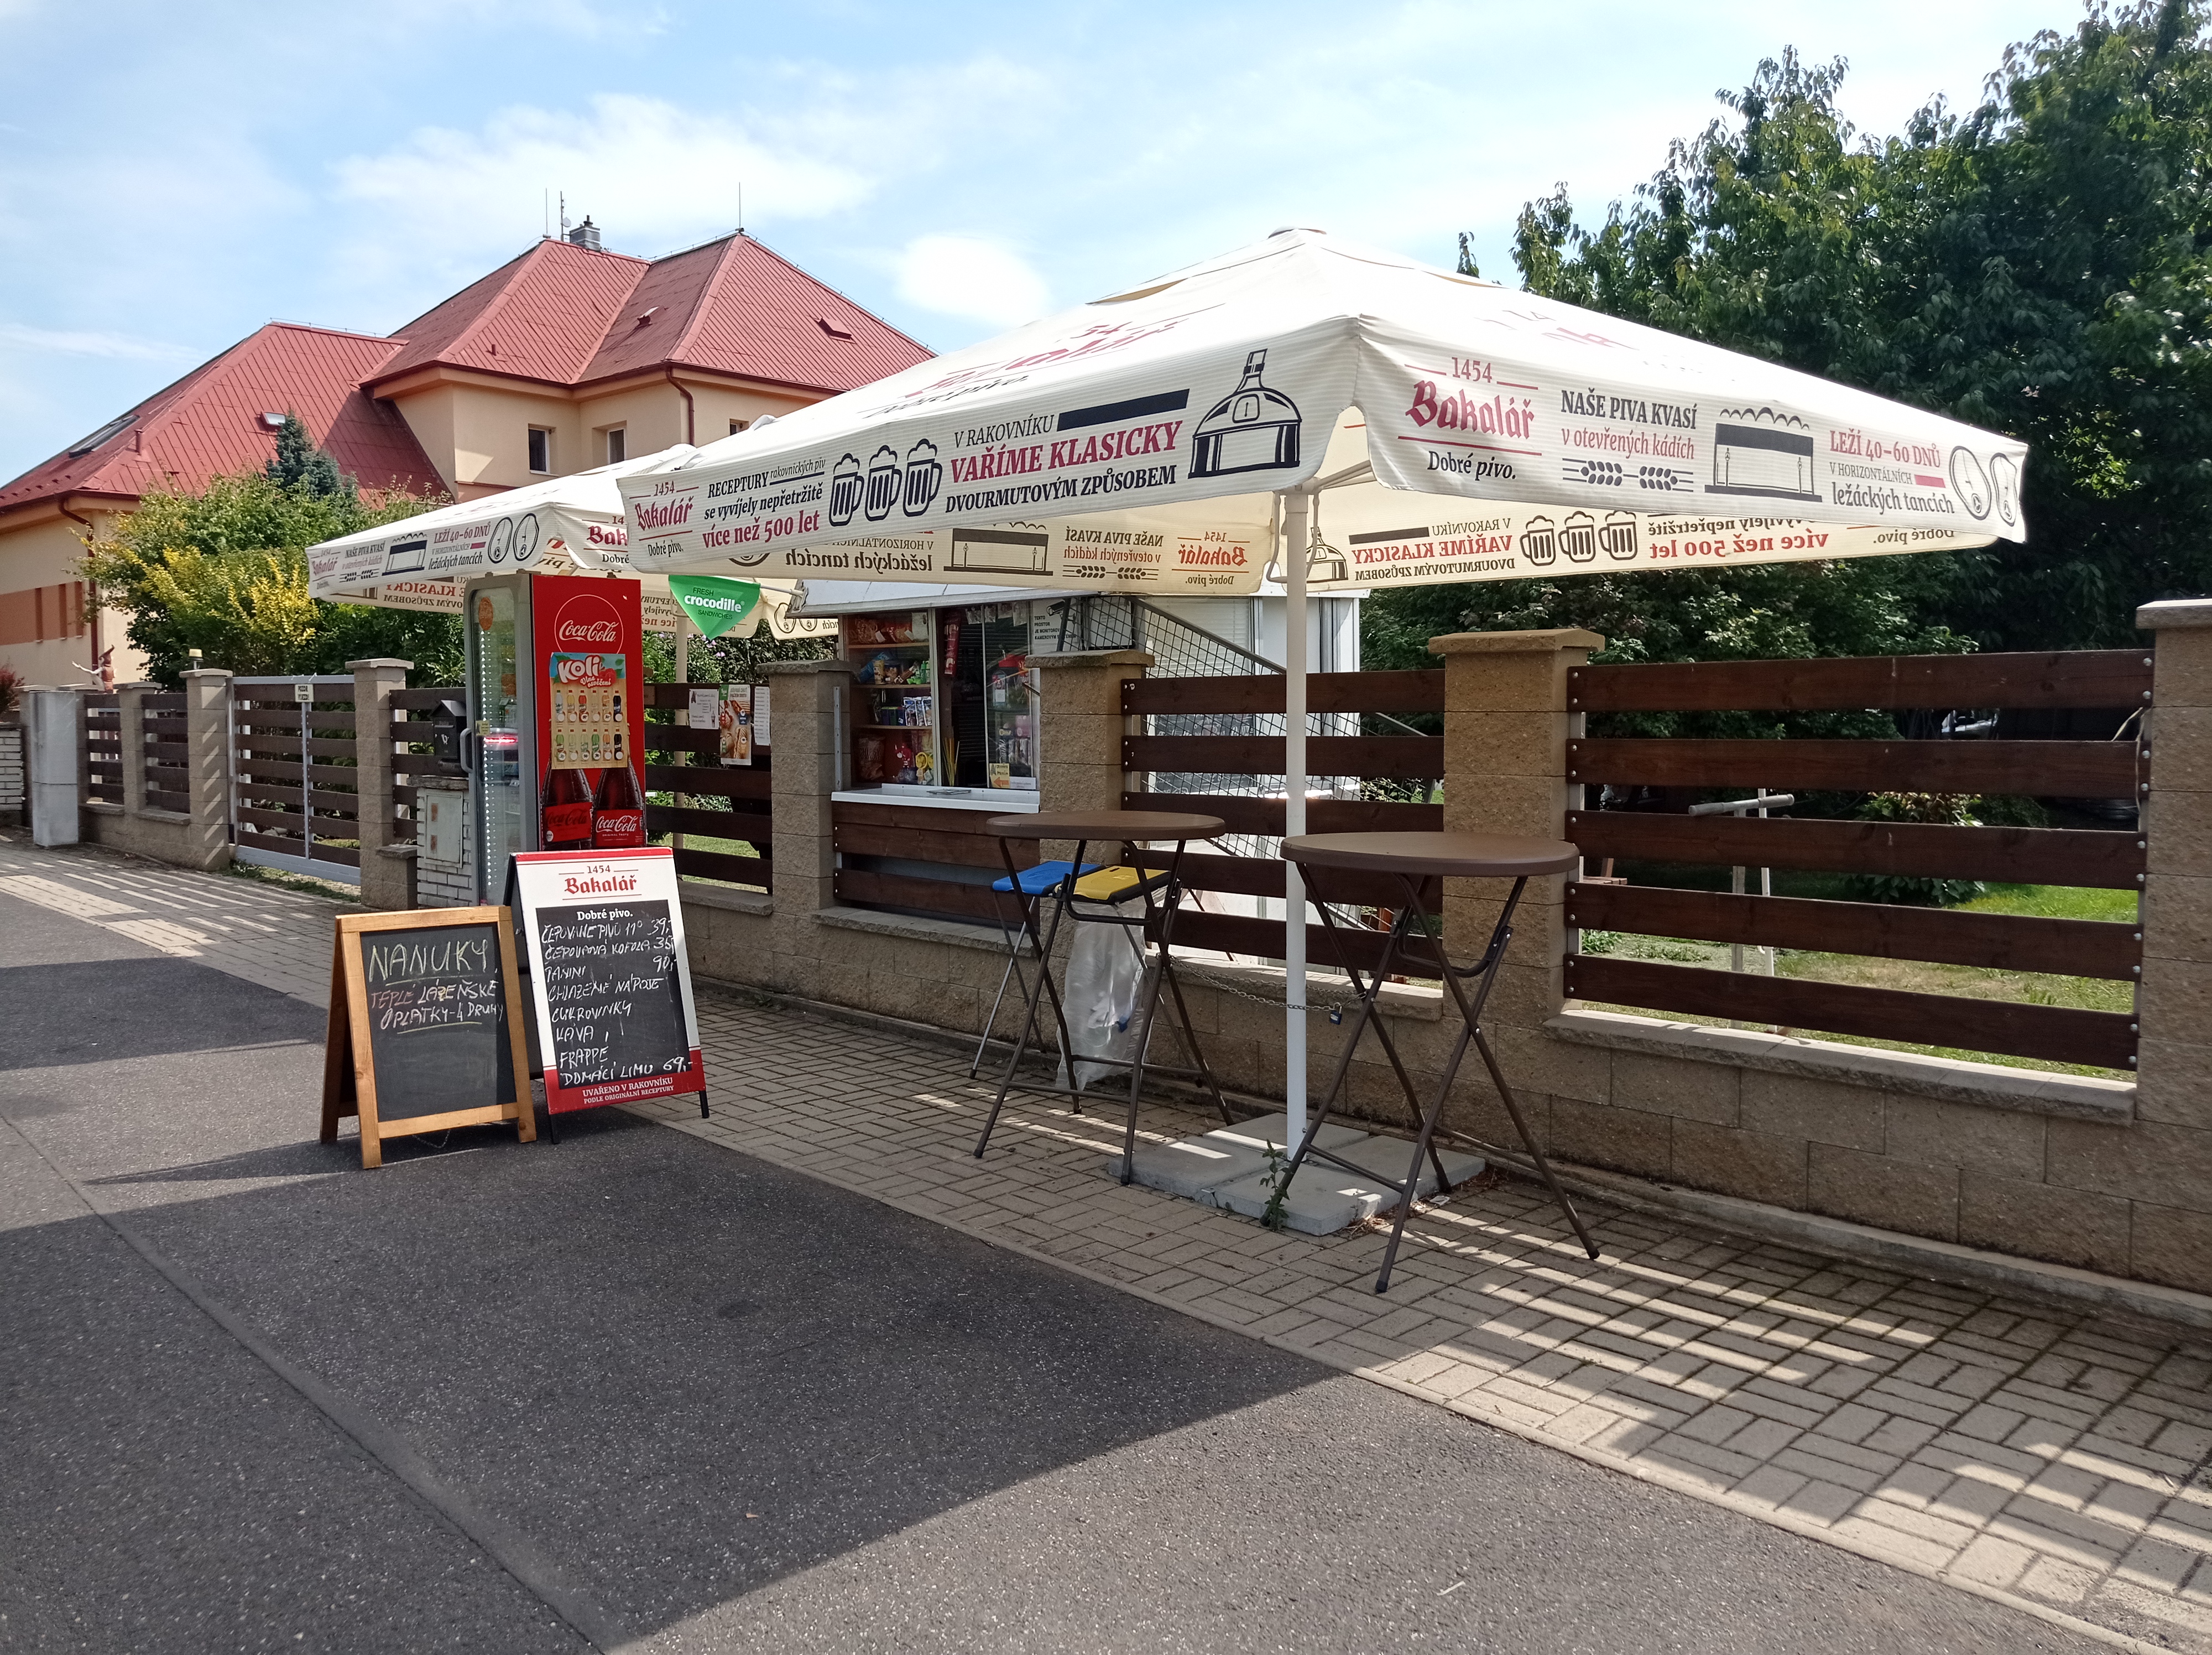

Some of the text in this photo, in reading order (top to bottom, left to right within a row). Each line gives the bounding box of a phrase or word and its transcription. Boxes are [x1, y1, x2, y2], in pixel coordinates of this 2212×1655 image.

[1452, 357, 1493, 383] 1454
[1405, 380, 1535, 439] Bakalář
[1561, 387, 1697, 429] NAŠE PIVA KVASÍ
[954, 414, 1055, 448] V RAKOVNÍKU
[951, 420, 1183, 483] VAŘÍME KLASICKY
[1561, 426, 1694, 460] v otevřených kádích
[1830, 428, 1862, 456] LEŽÍ
[1912, 443, 1941, 468] DNŮ
[1427, 451, 1516, 481] Dobré pivo.
[1829, 462, 1913, 485] V HORIZONTÁLNÍCH
[654, 480, 675, 496] 1454
[708, 457, 826, 498] RECEPTURY rakovnických piv
[945, 465, 1177, 513] DVOURMUTOVÝM ZPŮSOBEM
[1832, 481, 1955, 515] ležáckých tancích
[704, 482, 823, 521] se vyvíjely nepřetržitě
[635, 496, 694, 531] Bakalář
[434, 528, 451, 544] LEŽÍ
[473, 521, 491, 538] DNŮ
[702, 510, 820, 548] více než 500 let
[345, 547, 358, 558] NAŠE
[602, 554, 629, 563] Dobré
[648, 539, 684, 557] Dobré pivo.
[429, 551, 483, 571] ležáckých tancích
[693, 587, 714, 596] FRESH
[684, 595, 742, 612] crocodille
[698, 610, 733, 620] SANDWICHES
[559, 620, 619, 642] Coca-Cola
[596, 815, 638, 833] Coca-Cola
[587, 865, 611, 873] 1454
[565, 875, 637, 894] Bakalář
[577, 908, 633, 921] Dobré pivo.
[612, 940, 650, 954] KOFOLA
[369, 939, 488, 982] NANUKY
[467, 1002, 503, 1022] DRUHY
[582, 1084, 620, 1097] UVAŘENO
[629, 1077, 673, 1090] RAKOVNÍKU
[584, 1085, 674, 1104] PODLE ORIGINÁLNÍ RECEPTURY
